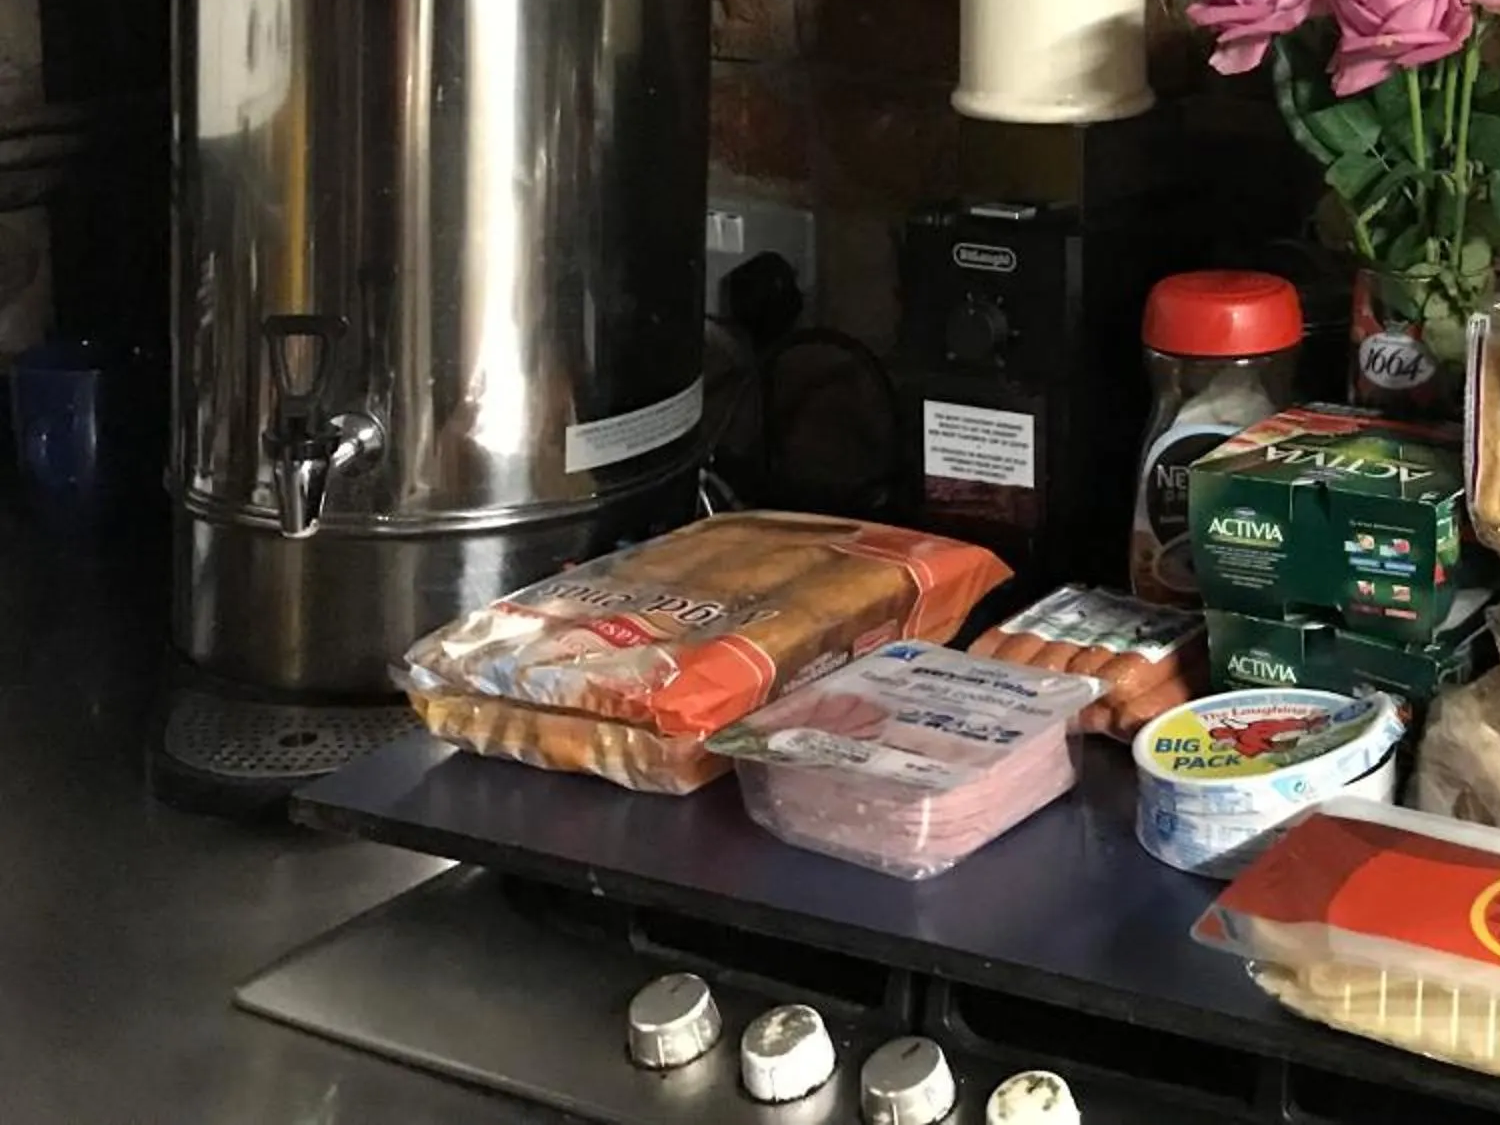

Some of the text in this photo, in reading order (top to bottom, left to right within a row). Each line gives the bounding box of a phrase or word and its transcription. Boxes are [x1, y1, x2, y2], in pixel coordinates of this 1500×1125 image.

[1365, 346, 1425, 381] 1664
[1266, 445, 1436, 482] ACTIVIA
[1208, 517, 1285, 542] ACTIVIA
[1227, 654, 1298, 684] ACTIVIA
[1155, 738, 1200, 754] BIG
[1172, 755, 1242, 771] PACK
